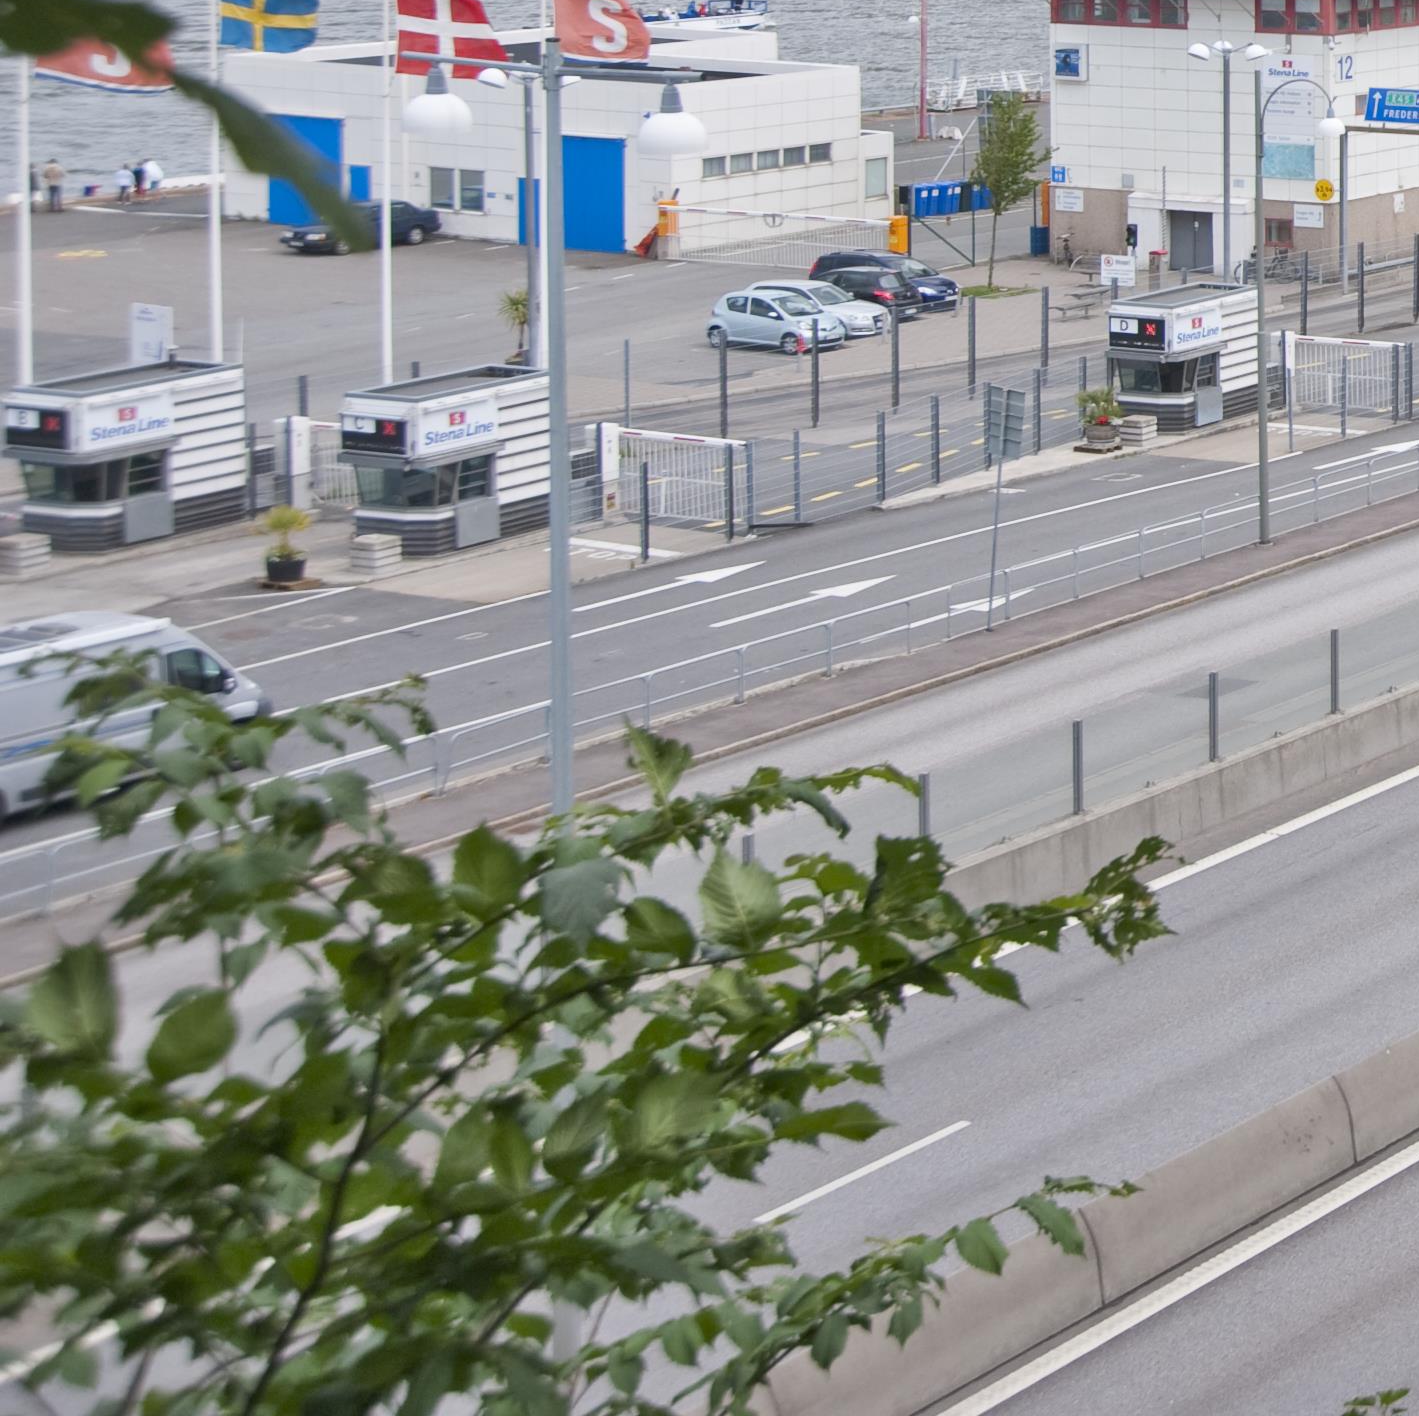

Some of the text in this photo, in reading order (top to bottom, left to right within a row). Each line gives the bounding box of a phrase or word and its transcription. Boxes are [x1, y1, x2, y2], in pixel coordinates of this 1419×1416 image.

[1268, 68, 1309, 78] Stena Line
[1337, 55, 1353, 81] 12
[1120, 320, 1129, 331] D
[1176, 332, 1201, 344] Stena
[1202, 326, 1220, 338] Line
[91, 417, 170, 441] Stena Line
[425, 428, 465, 446] Stena
[466, 421, 494, 437] Line
